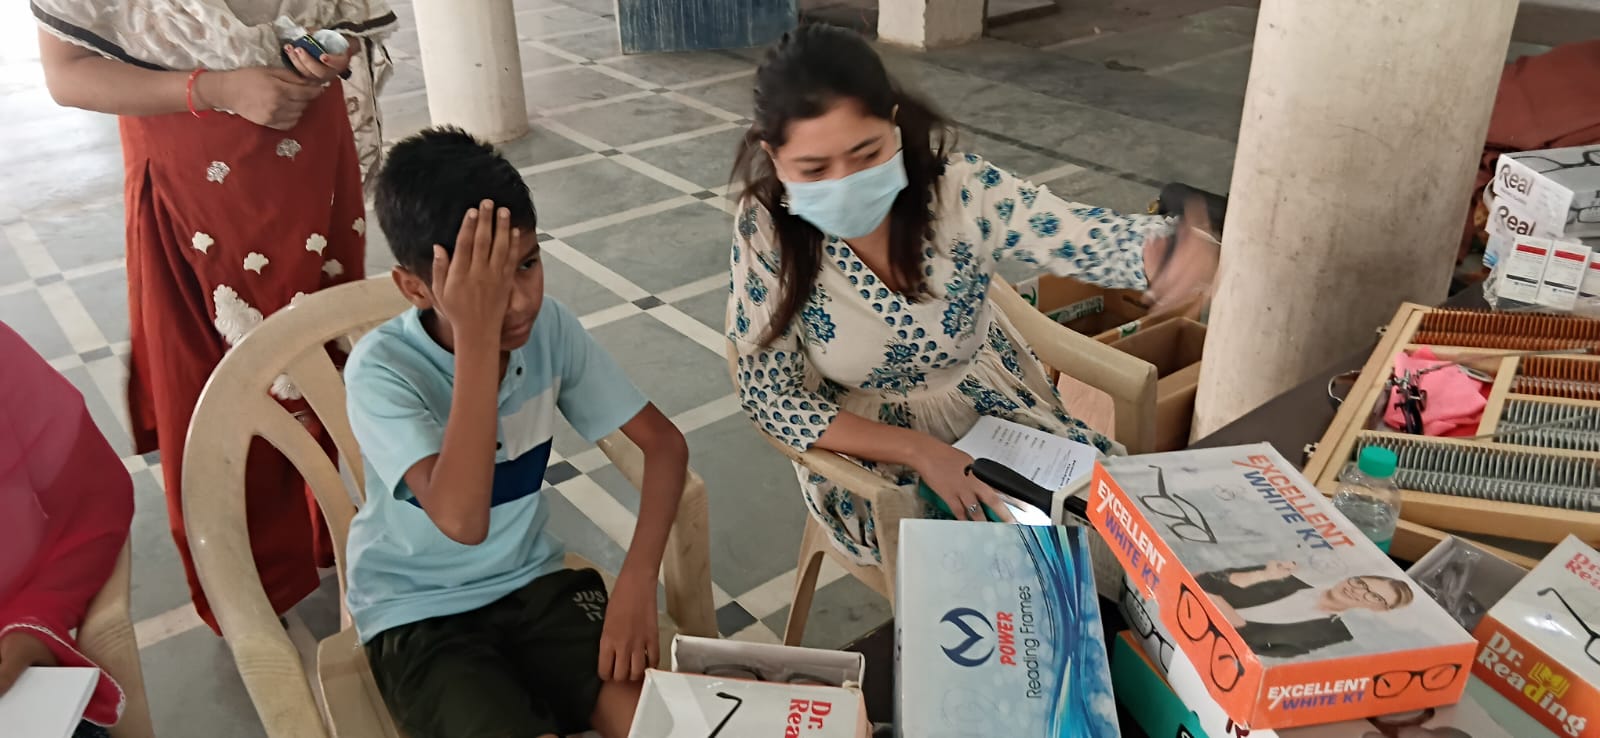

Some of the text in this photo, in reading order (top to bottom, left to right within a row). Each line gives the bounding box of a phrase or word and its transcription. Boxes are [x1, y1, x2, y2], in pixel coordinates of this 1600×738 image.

[1499, 163, 1535, 196] Real
[1496, 206, 1537, 236] Real
[1232, 454, 1356, 547] EXCELLENT
[1243, 470, 1306, 524] WHITE
[1096, 479, 1167, 574] EXCELLENT
[1104, 511, 1142, 569] WHITE
[996, 611, 1017, 667] POWER
[1019, 585, 1042, 699] Reading Frames
[1486, 631, 1524, 668] Dr.
[808, 701, 832, 730] Dr.
[1267, 677, 1370, 711] EXCELLENT
[1282, 695, 1338, 711] WHITE
[1476, 646, 1588, 738] Reading
